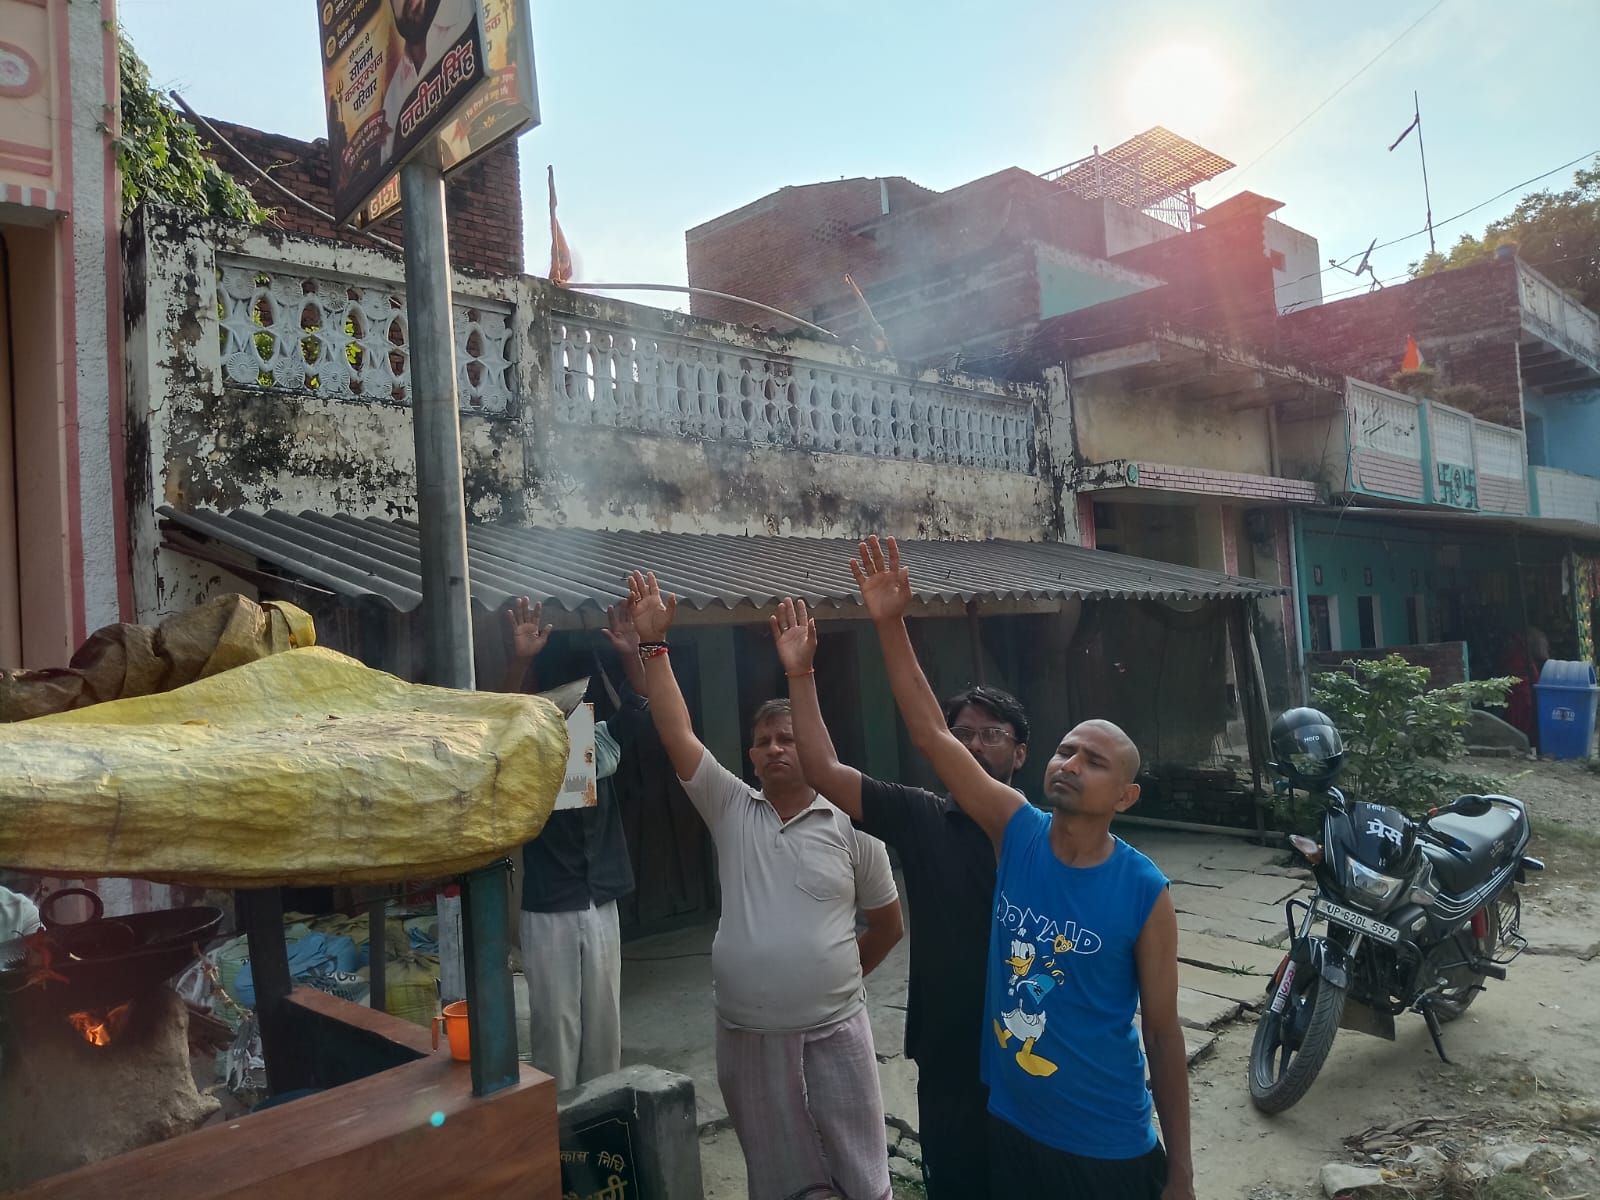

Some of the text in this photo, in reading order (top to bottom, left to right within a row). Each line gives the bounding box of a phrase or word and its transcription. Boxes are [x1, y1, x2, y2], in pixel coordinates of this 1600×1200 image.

[349, 46, 373, 81] सोनम
[353, 78, 377, 111] परिवार
[400, 39, 475, 137] नवीन सिंह
[1366, 818, 1404, 846] प्रेस
[1327, 903, 1340, 915] UP
[1343, 911, 1367, 929] 62DL
